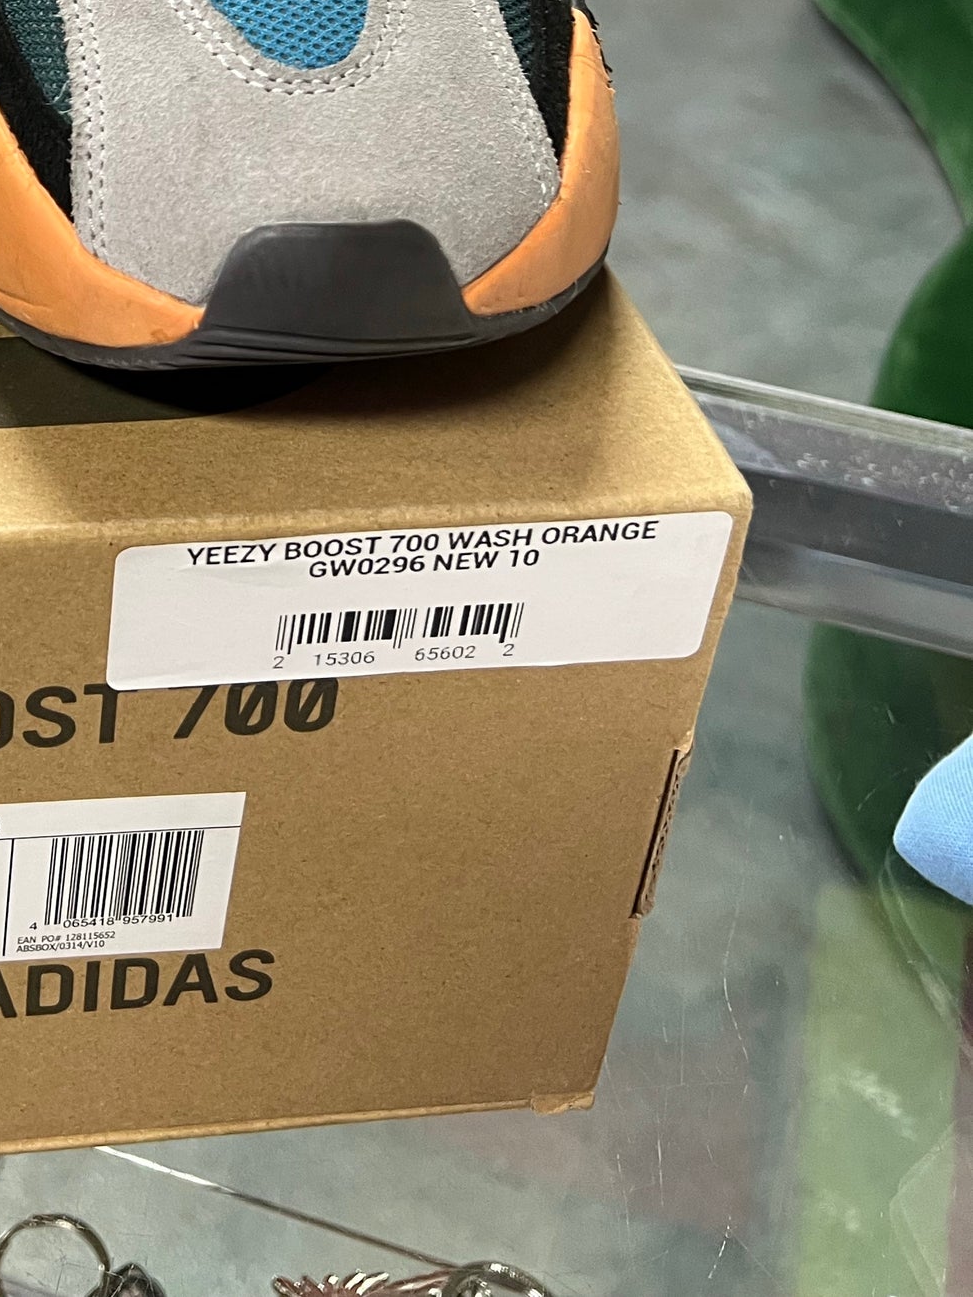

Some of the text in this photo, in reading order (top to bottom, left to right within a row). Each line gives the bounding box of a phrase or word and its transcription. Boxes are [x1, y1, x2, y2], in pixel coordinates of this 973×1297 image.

[187, 520, 660, 566] YEEZY BOOST 700 WASH ORANGE
[309, 549, 540, 578] GW0296 NEW 10
[272, 643, 515, 669] 2 15306 65602 2
[169, 677, 339, 739] 700
[29, 913, 174, 930] 4 065418 957991
[16, 940, 105, 953] ABSBOX/0314/V10
[17, 931, 116, 945] EAN PO# 128115652
